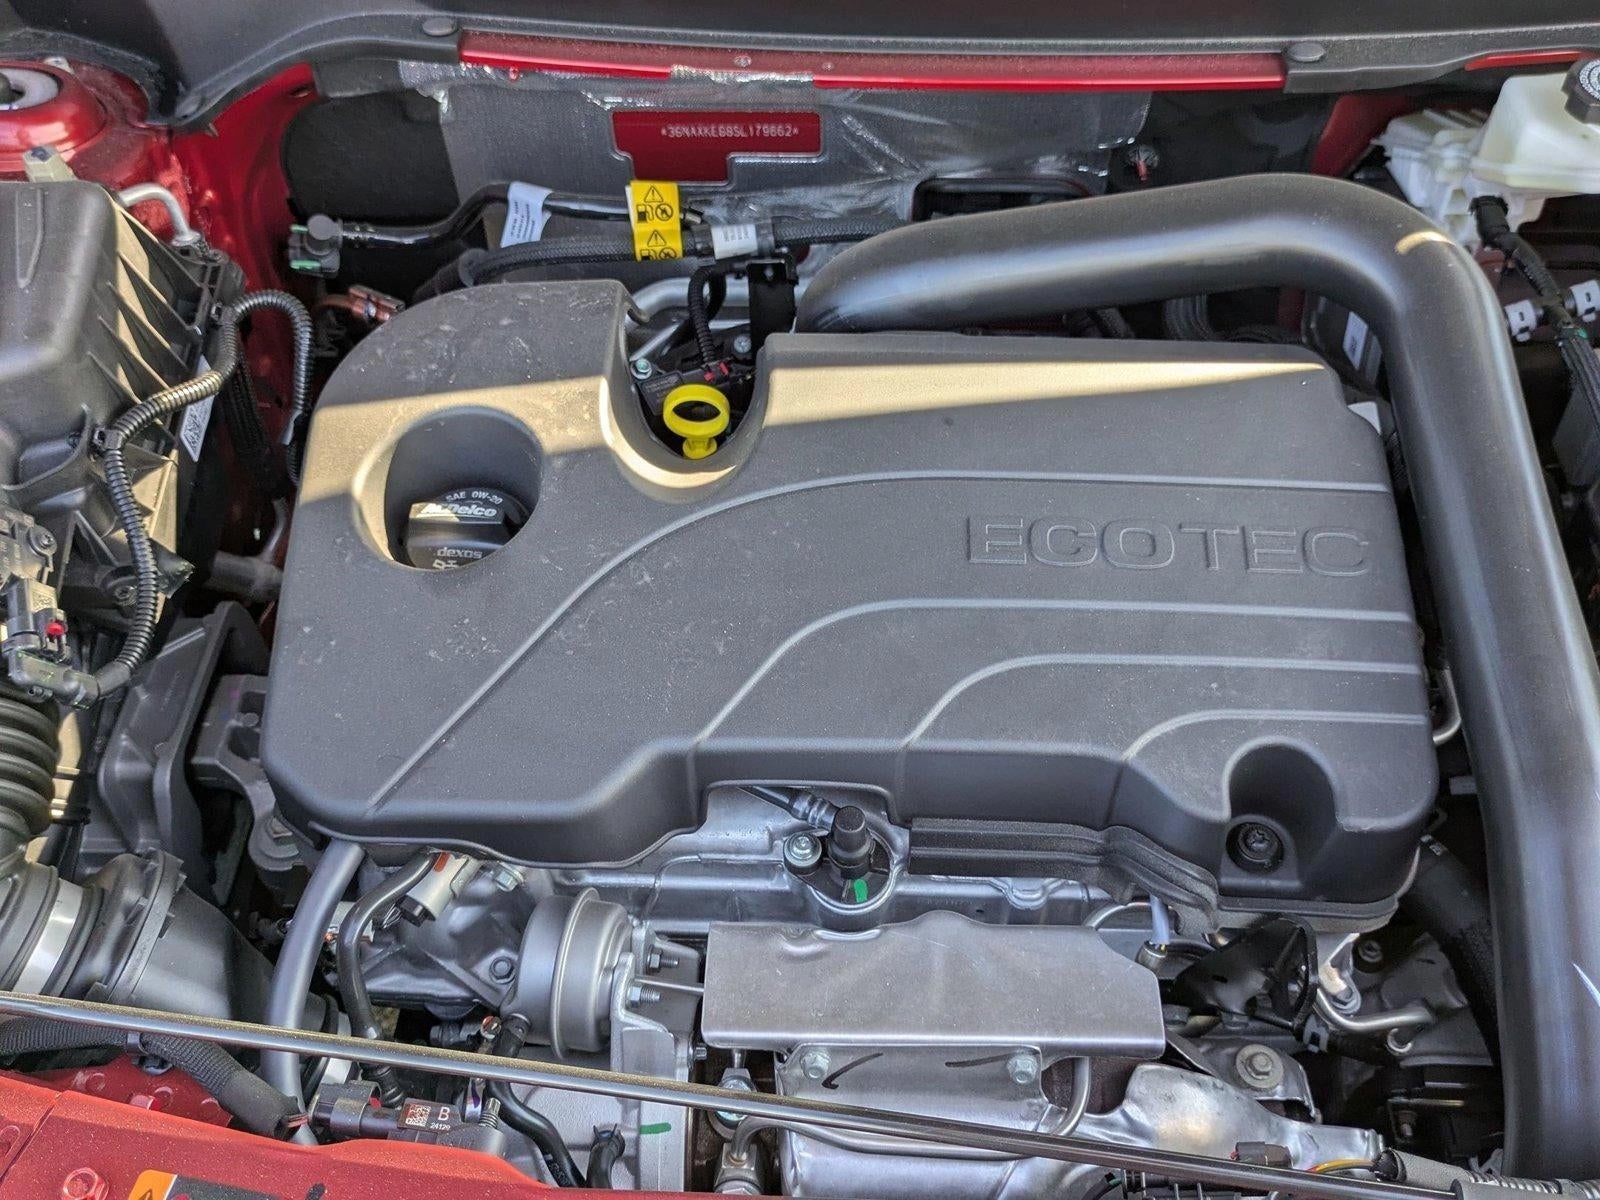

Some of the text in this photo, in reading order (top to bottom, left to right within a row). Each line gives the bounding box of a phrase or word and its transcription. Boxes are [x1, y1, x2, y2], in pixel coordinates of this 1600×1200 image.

[446, 490, 503, 505] SAE 0W-20
[436, 546, 483, 558] dexos
[966, 515, 1370, 577] ECOTEC
[437, 1106, 450, 1121] B
